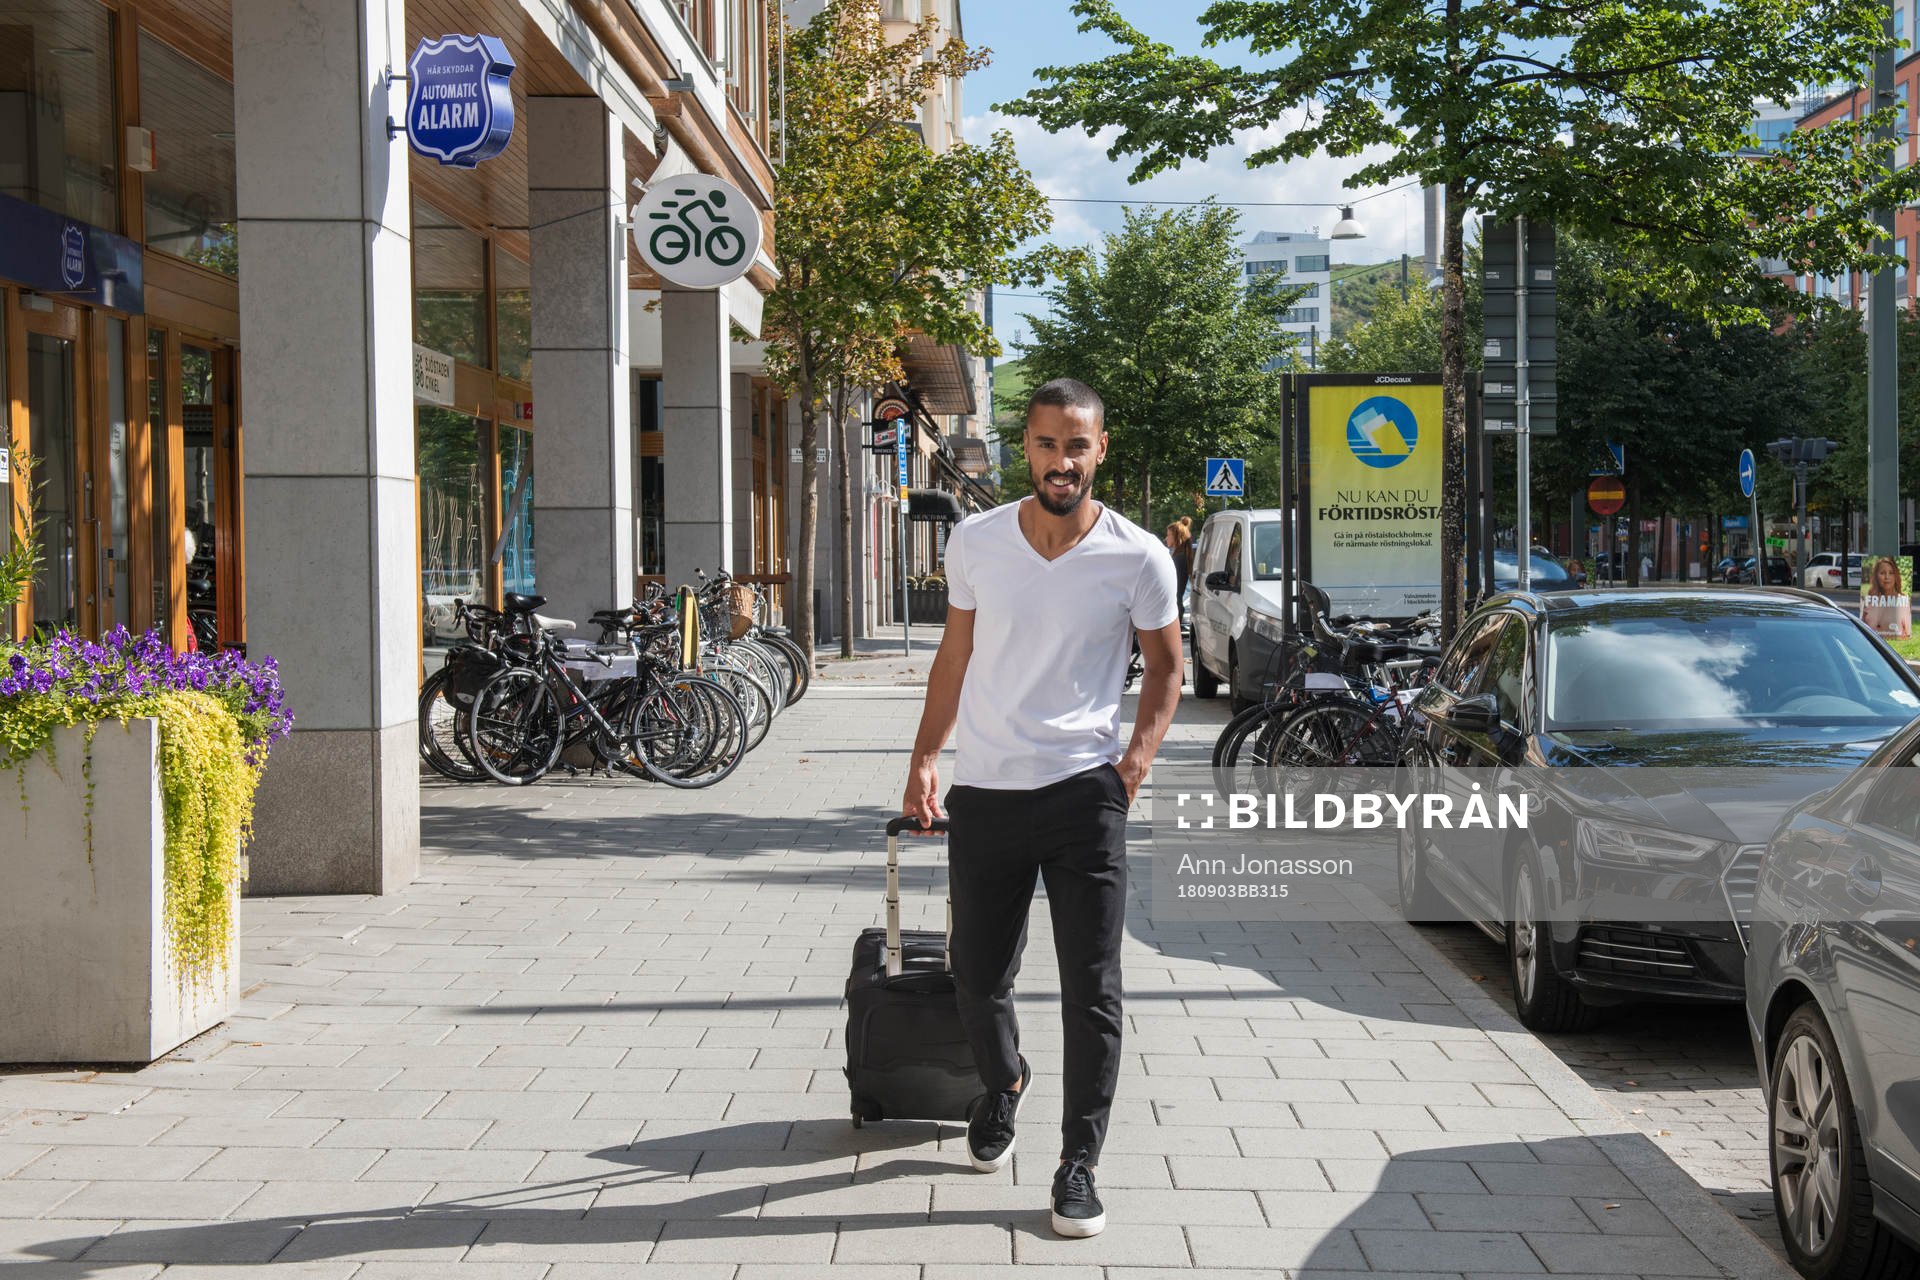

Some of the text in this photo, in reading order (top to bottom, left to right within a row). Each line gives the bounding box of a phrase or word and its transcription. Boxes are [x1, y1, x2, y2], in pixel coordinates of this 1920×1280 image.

[427, 64, 474, 75] HÄR SKYDDAR
[421, 82, 478, 101] AUTOMATIC
[417, 102, 479, 130] ALARM
[425, 375, 440, 393] CYKEL
[1374, 376, 1412, 384] JCDecaux
[1337, 489, 1429, 503] NU KAN DU
[1334, 530, 1433, 540] Gå in på röstaistockholm.se
[1333, 540, 1344, 548] för
[1380, 539, 1433, 548] röstningslokal.
